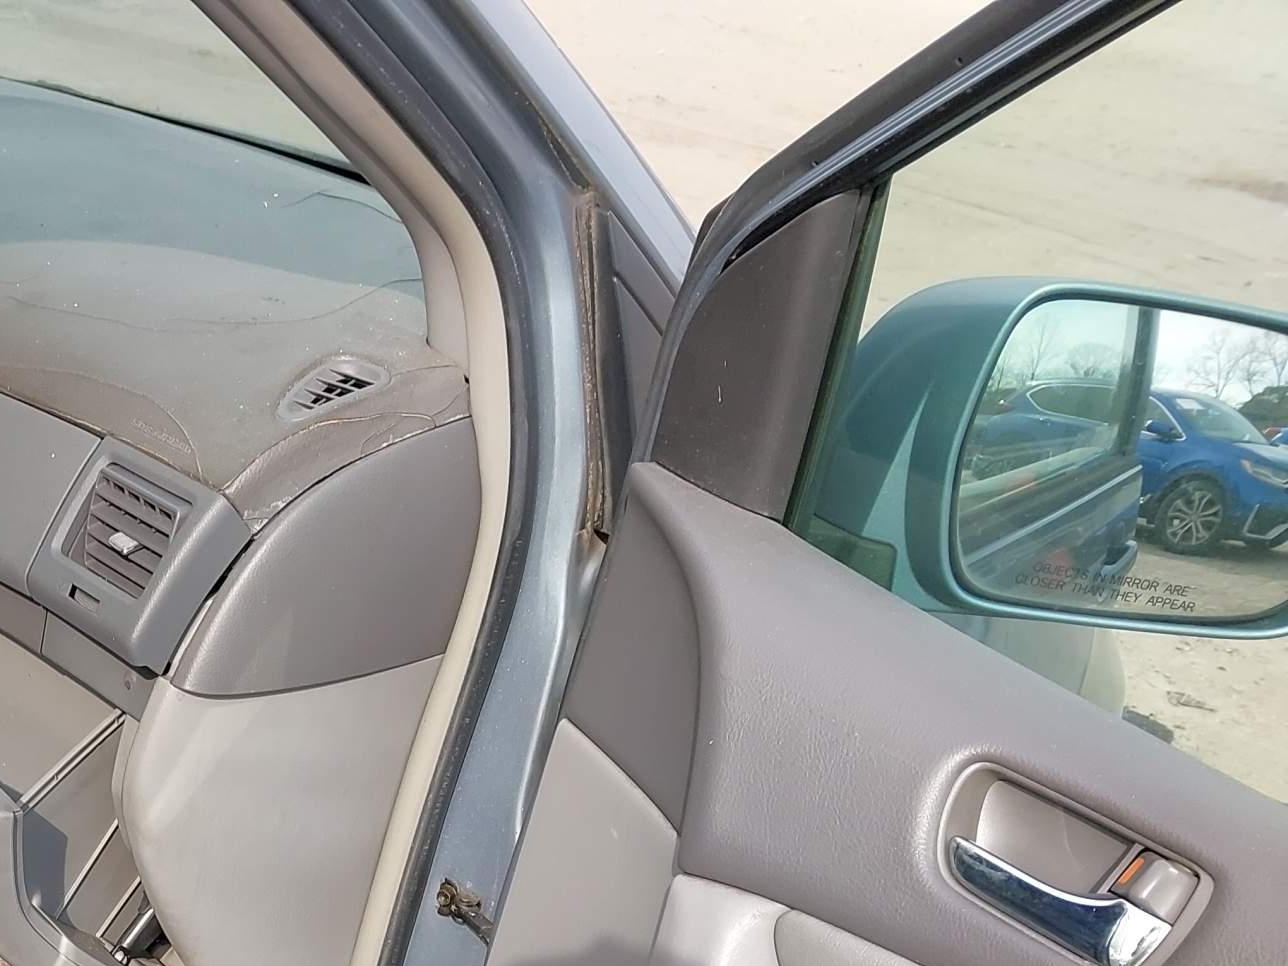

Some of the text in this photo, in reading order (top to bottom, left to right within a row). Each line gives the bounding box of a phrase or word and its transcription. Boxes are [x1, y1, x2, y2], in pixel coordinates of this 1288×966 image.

[1015, 573, 1196, 612] CLOSER THAN THEY APPEAR
[1032, 561, 1191, 597] OBJECTS IN MIRROR ARE
